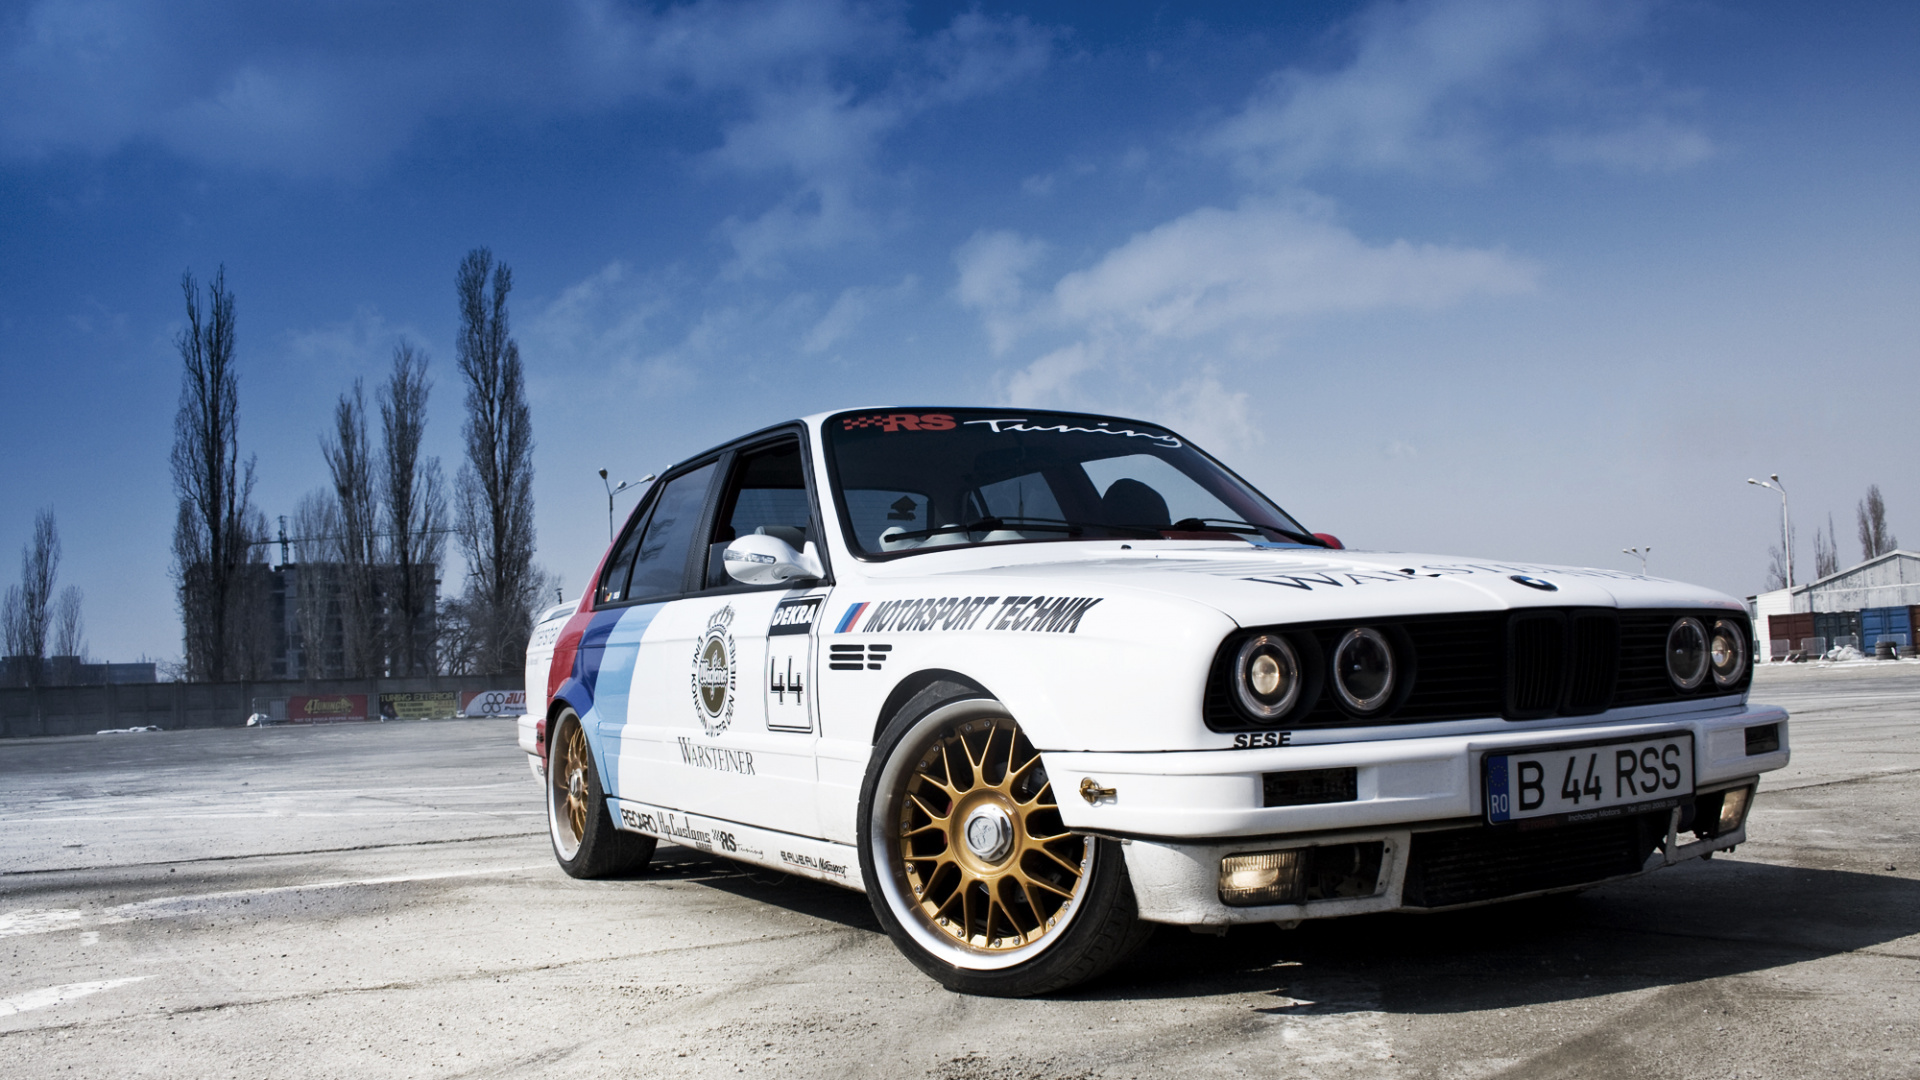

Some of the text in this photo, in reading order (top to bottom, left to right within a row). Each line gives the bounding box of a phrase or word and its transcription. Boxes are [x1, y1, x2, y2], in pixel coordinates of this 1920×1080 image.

[883, 413, 1182, 448] RS Tuning
[772, 604, 817, 626] DEKRA
[862, 596, 1104, 633] MOTORSPORT TECHNIK
[770, 656, 804, 705] 44
[678, 736, 756, 775] WARSTEINER
[1233, 732, 1292, 749] SESE
[1518, 744, 1680, 811] B 44 RSS
[1491, 793, 1508, 814] RO
[621, 808, 658, 834] RECARO
[720, 831, 737, 852] RS
